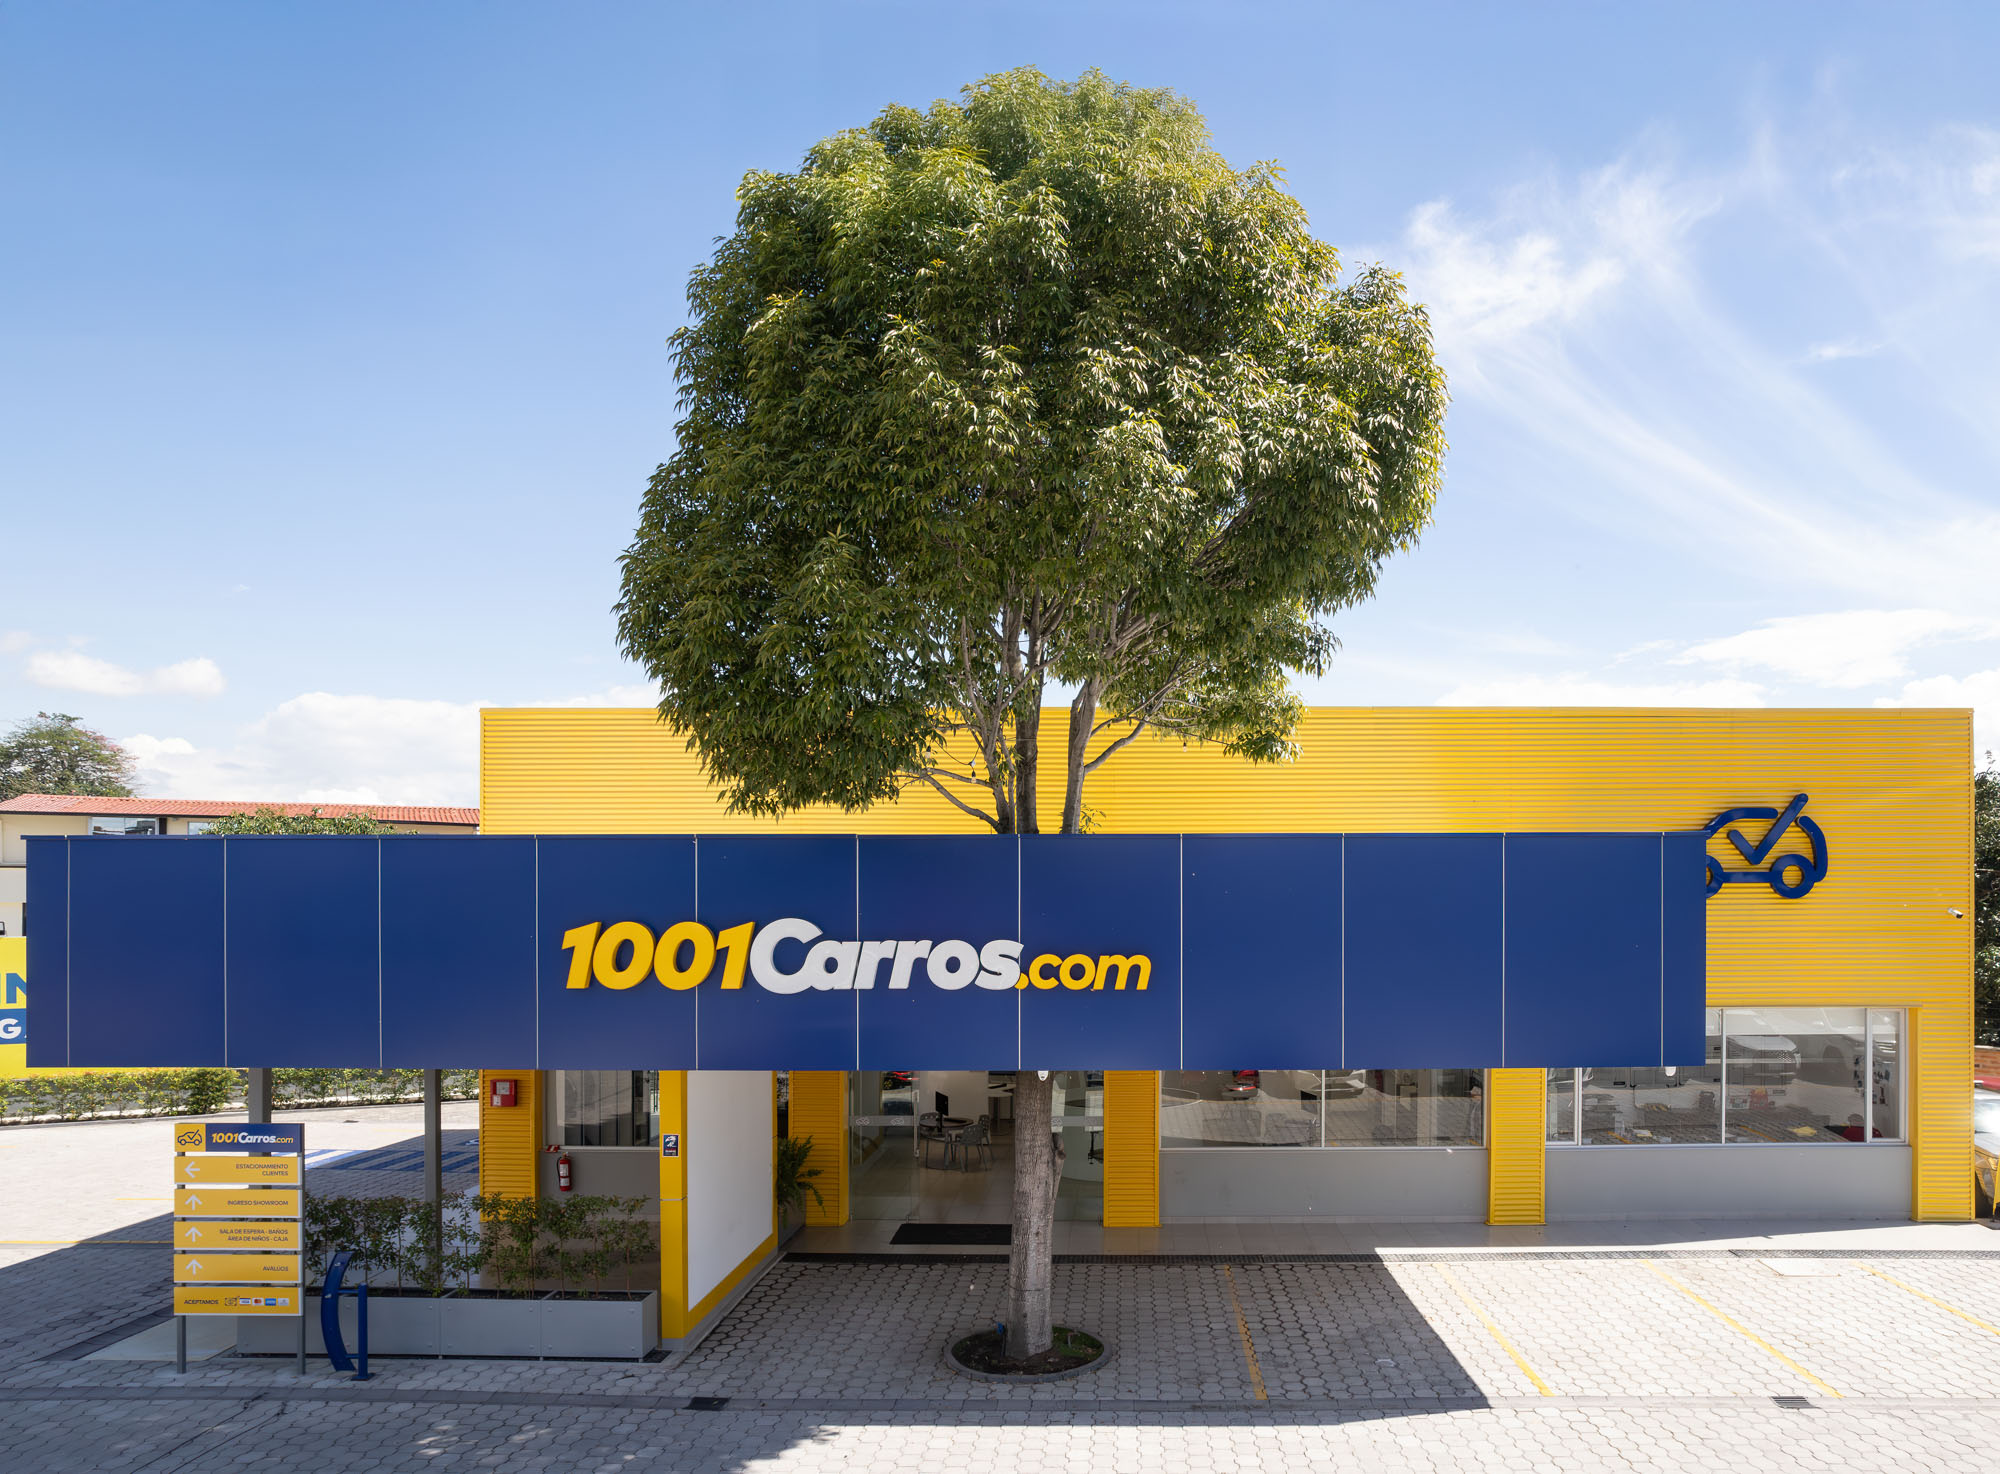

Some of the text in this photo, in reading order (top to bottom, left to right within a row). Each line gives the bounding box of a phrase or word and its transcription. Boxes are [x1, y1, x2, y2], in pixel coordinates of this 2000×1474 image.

[561, 917, 1152, 995] 1001Carros.com
[211, 1132, 294, 1144] 1001Carros.com
[251, 1234, 270, 1242] NIÑOS
